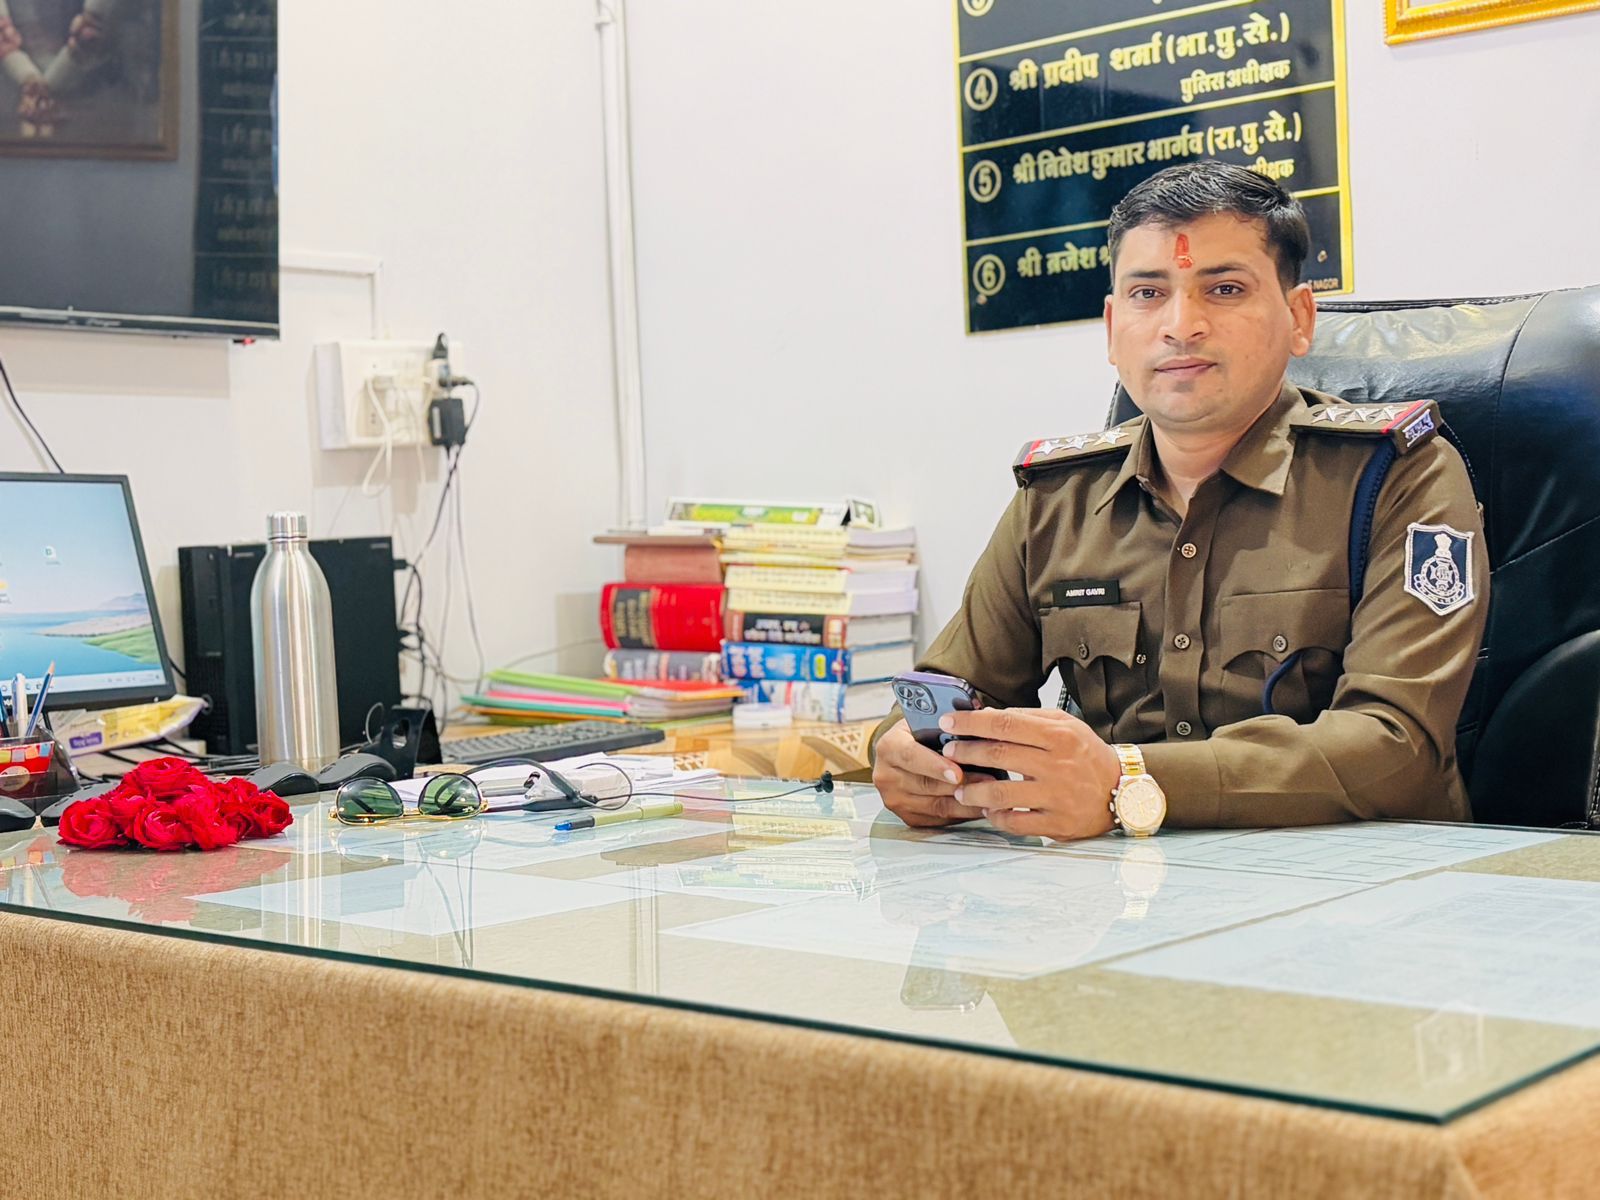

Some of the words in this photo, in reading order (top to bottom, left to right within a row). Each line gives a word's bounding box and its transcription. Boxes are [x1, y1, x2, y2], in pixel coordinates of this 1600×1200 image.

[1009, 58, 1038, 91] श्री
[1042, 47, 1100, 89] प्रदीप
[1109, 31, 1162, 71] शर्मा
[1180, 69, 1226, 103] पुलिस
[1226, 58, 1291, 88] अधीक्षक
[1013, 152, 1036, 184] श्री
[1090, 141, 1145, 180] कुमार
[1147, 124, 1204, 161] भार्गव
[1017, 247, 1042, 277] श्री
